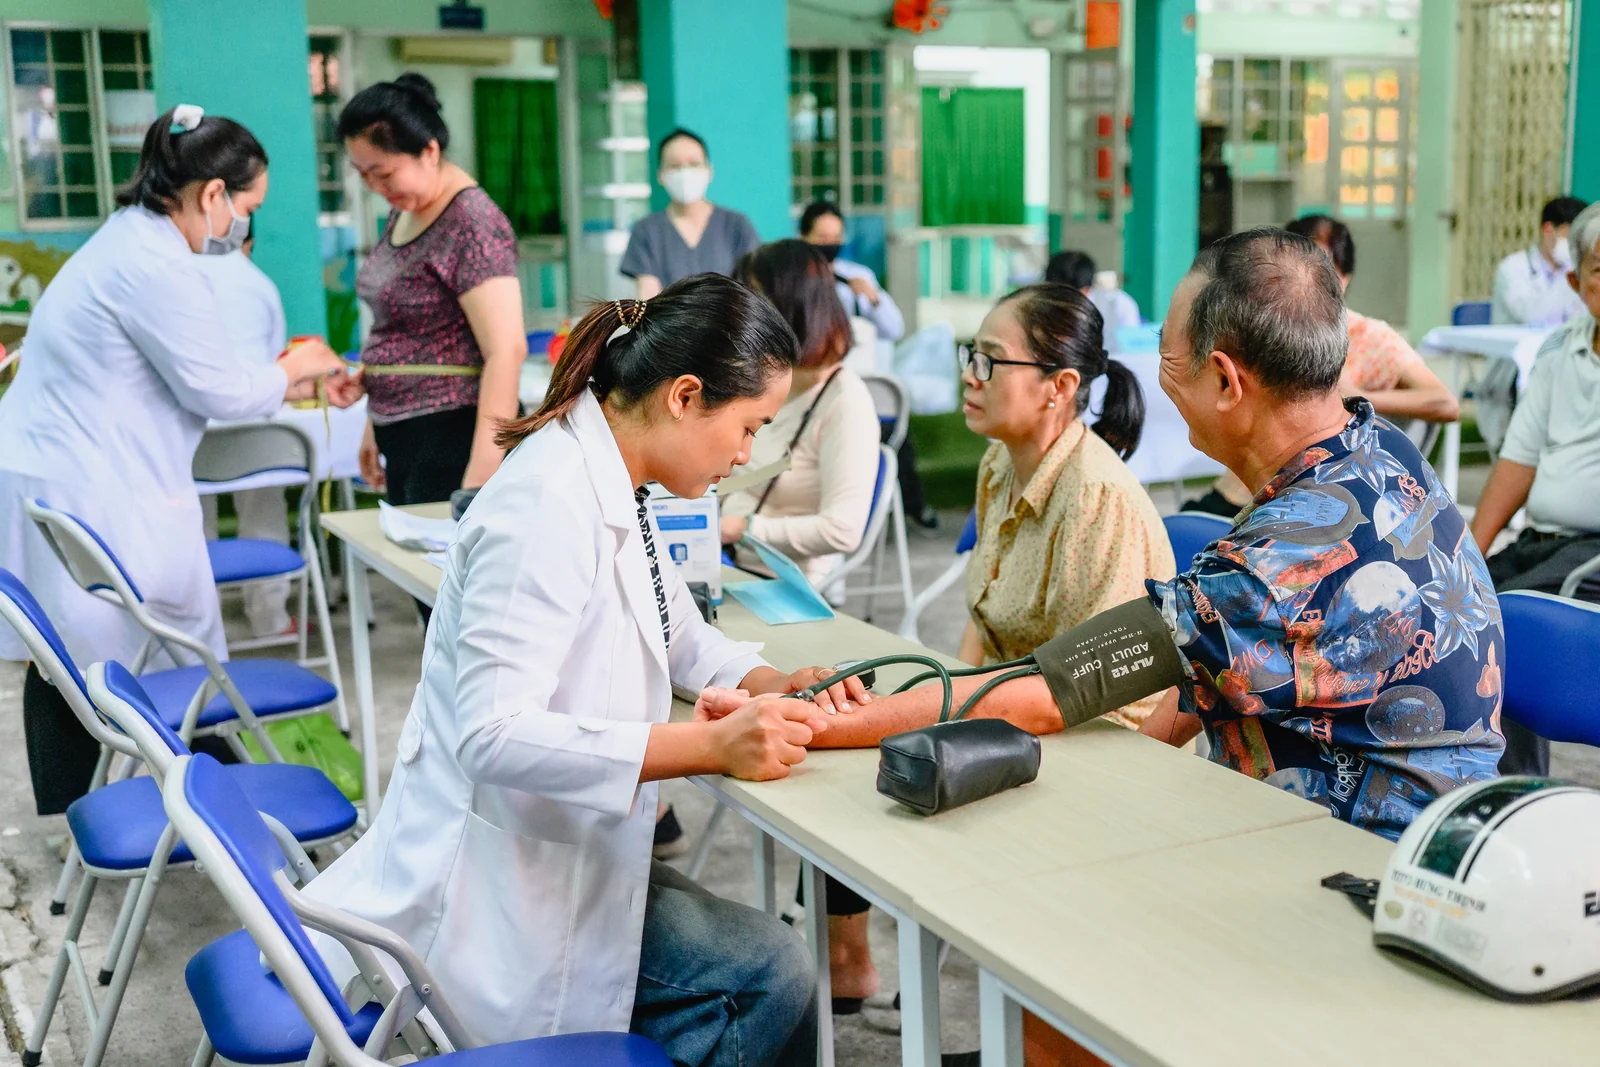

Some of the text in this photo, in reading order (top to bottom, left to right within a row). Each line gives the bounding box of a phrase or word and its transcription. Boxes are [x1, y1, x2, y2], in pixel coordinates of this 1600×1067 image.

[1098, 639, 1117, 649] Upper
[1082, 647, 1094, 655] Arm
[1065, 654, 1079, 663] Size
[1072, 642, 1149, 679] ADULT CUFF
